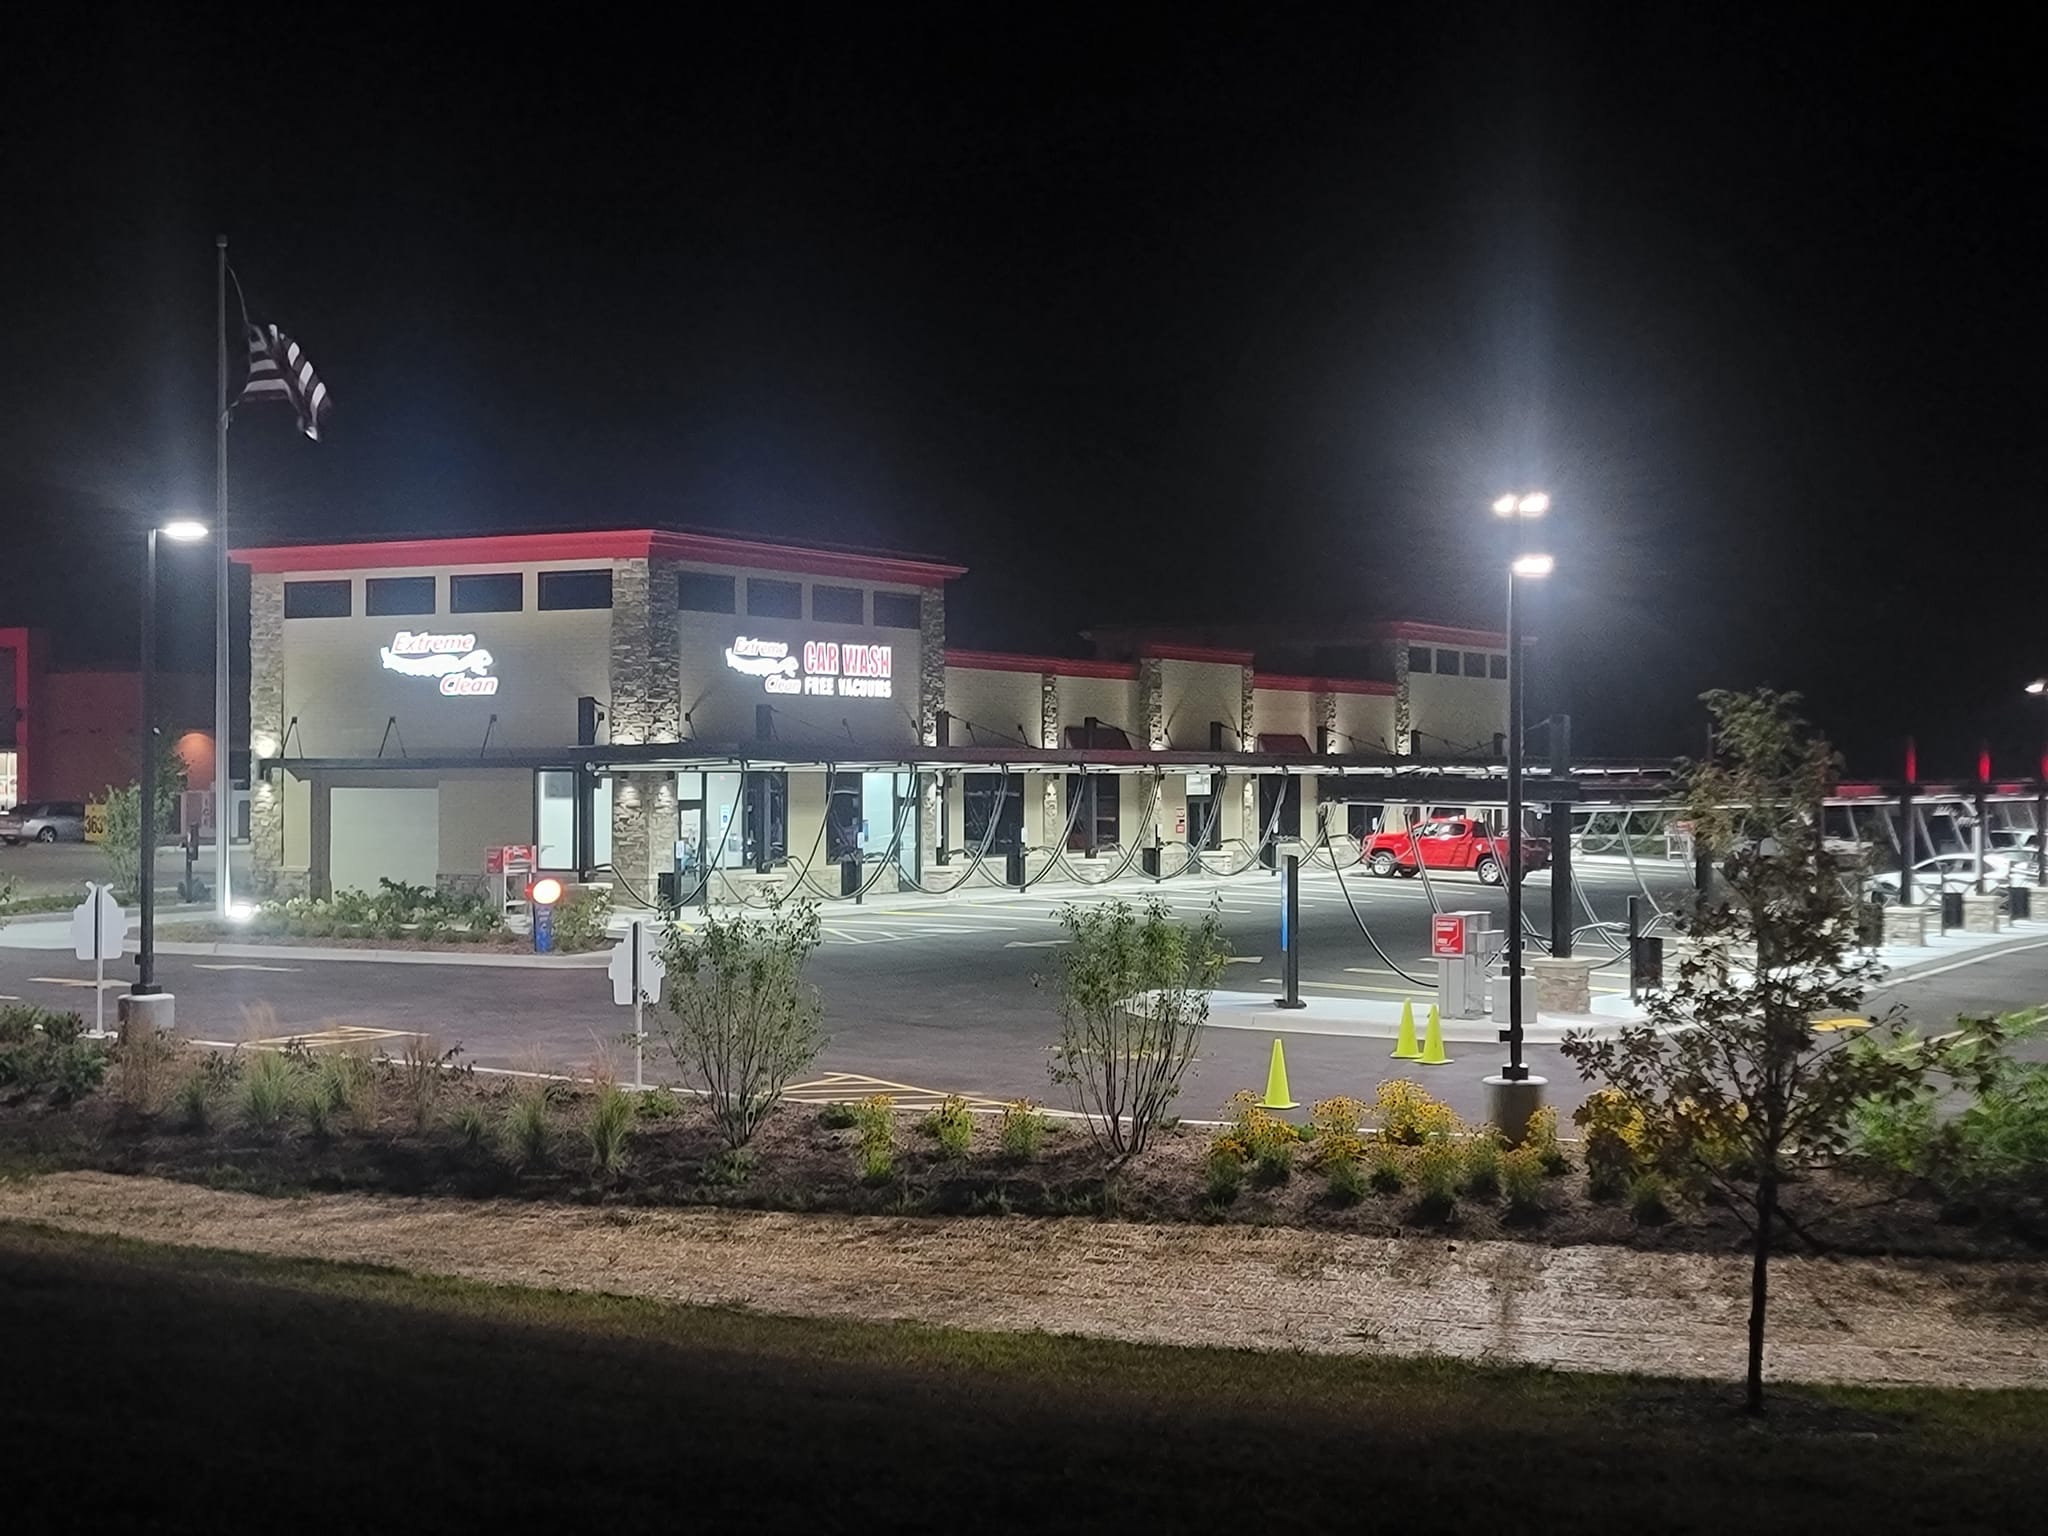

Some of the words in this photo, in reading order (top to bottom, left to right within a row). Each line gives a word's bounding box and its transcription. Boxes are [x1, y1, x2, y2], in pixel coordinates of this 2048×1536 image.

[393, 633, 475, 653] Extreme
[734, 638, 788, 657] Extreme
[804, 642, 839, 674] CAR
[843, 645, 892, 677] WASH
[441, 674, 498, 694] Clean
[766, 676, 801, 694] Clean
[804, 677, 834, 695] FREE
[838, 679, 892, 698] VACUUMS
